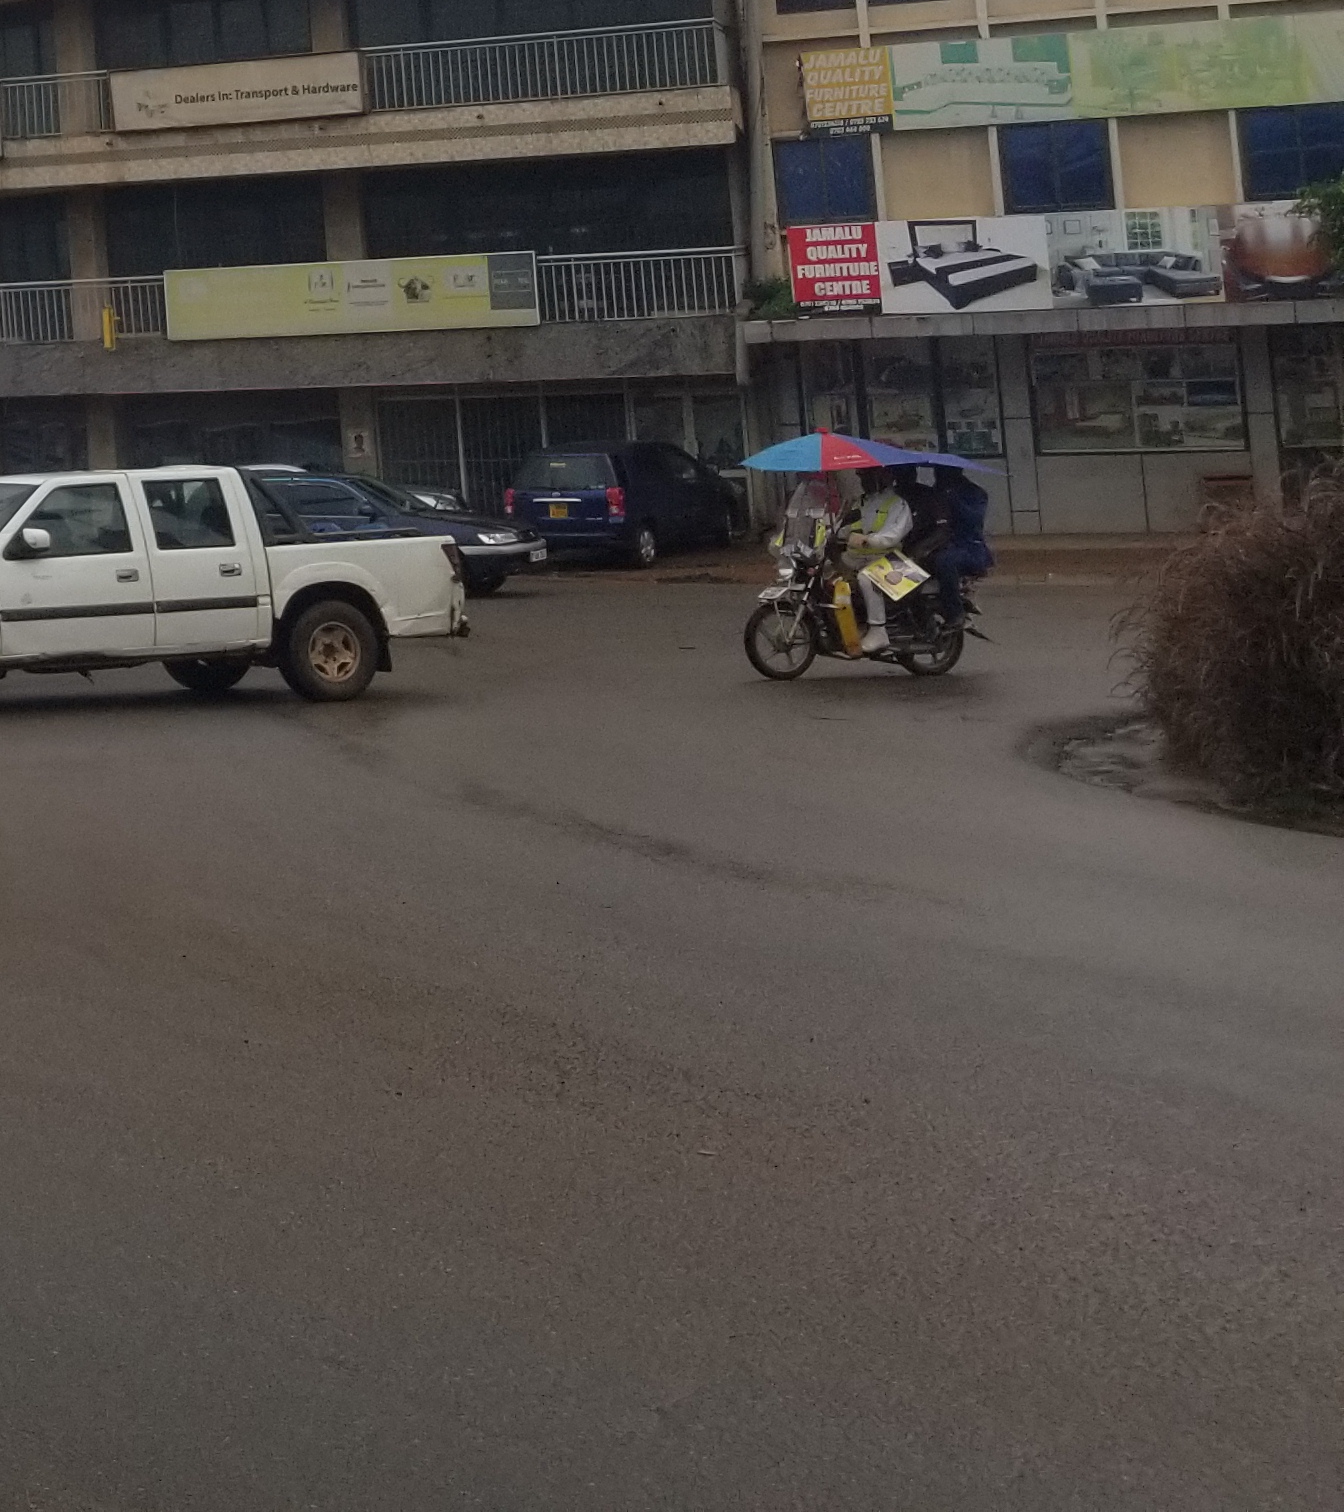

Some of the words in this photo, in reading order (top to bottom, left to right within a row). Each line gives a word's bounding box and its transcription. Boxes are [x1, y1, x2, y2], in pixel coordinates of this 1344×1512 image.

[802, 49, 882, 69] JAMALU
[807, 65, 883, 85] QUALITY
[174, 93, 216, 105] Dealers
[234, 87, 289, 102] Transport
[291, 85, 300, 95] &
[302, 82, 358, 95] Hardware
[806, 83, 888, 101] FURNITURE
[813, 98, 885, 117] CENTRE
[805, 225, 862, 242] JAMALU
[806, 243, 868, 261] QUALITY
[796, 261, 878, 279] FURNITURE
[814, 280, 871, 296] CENTRE
